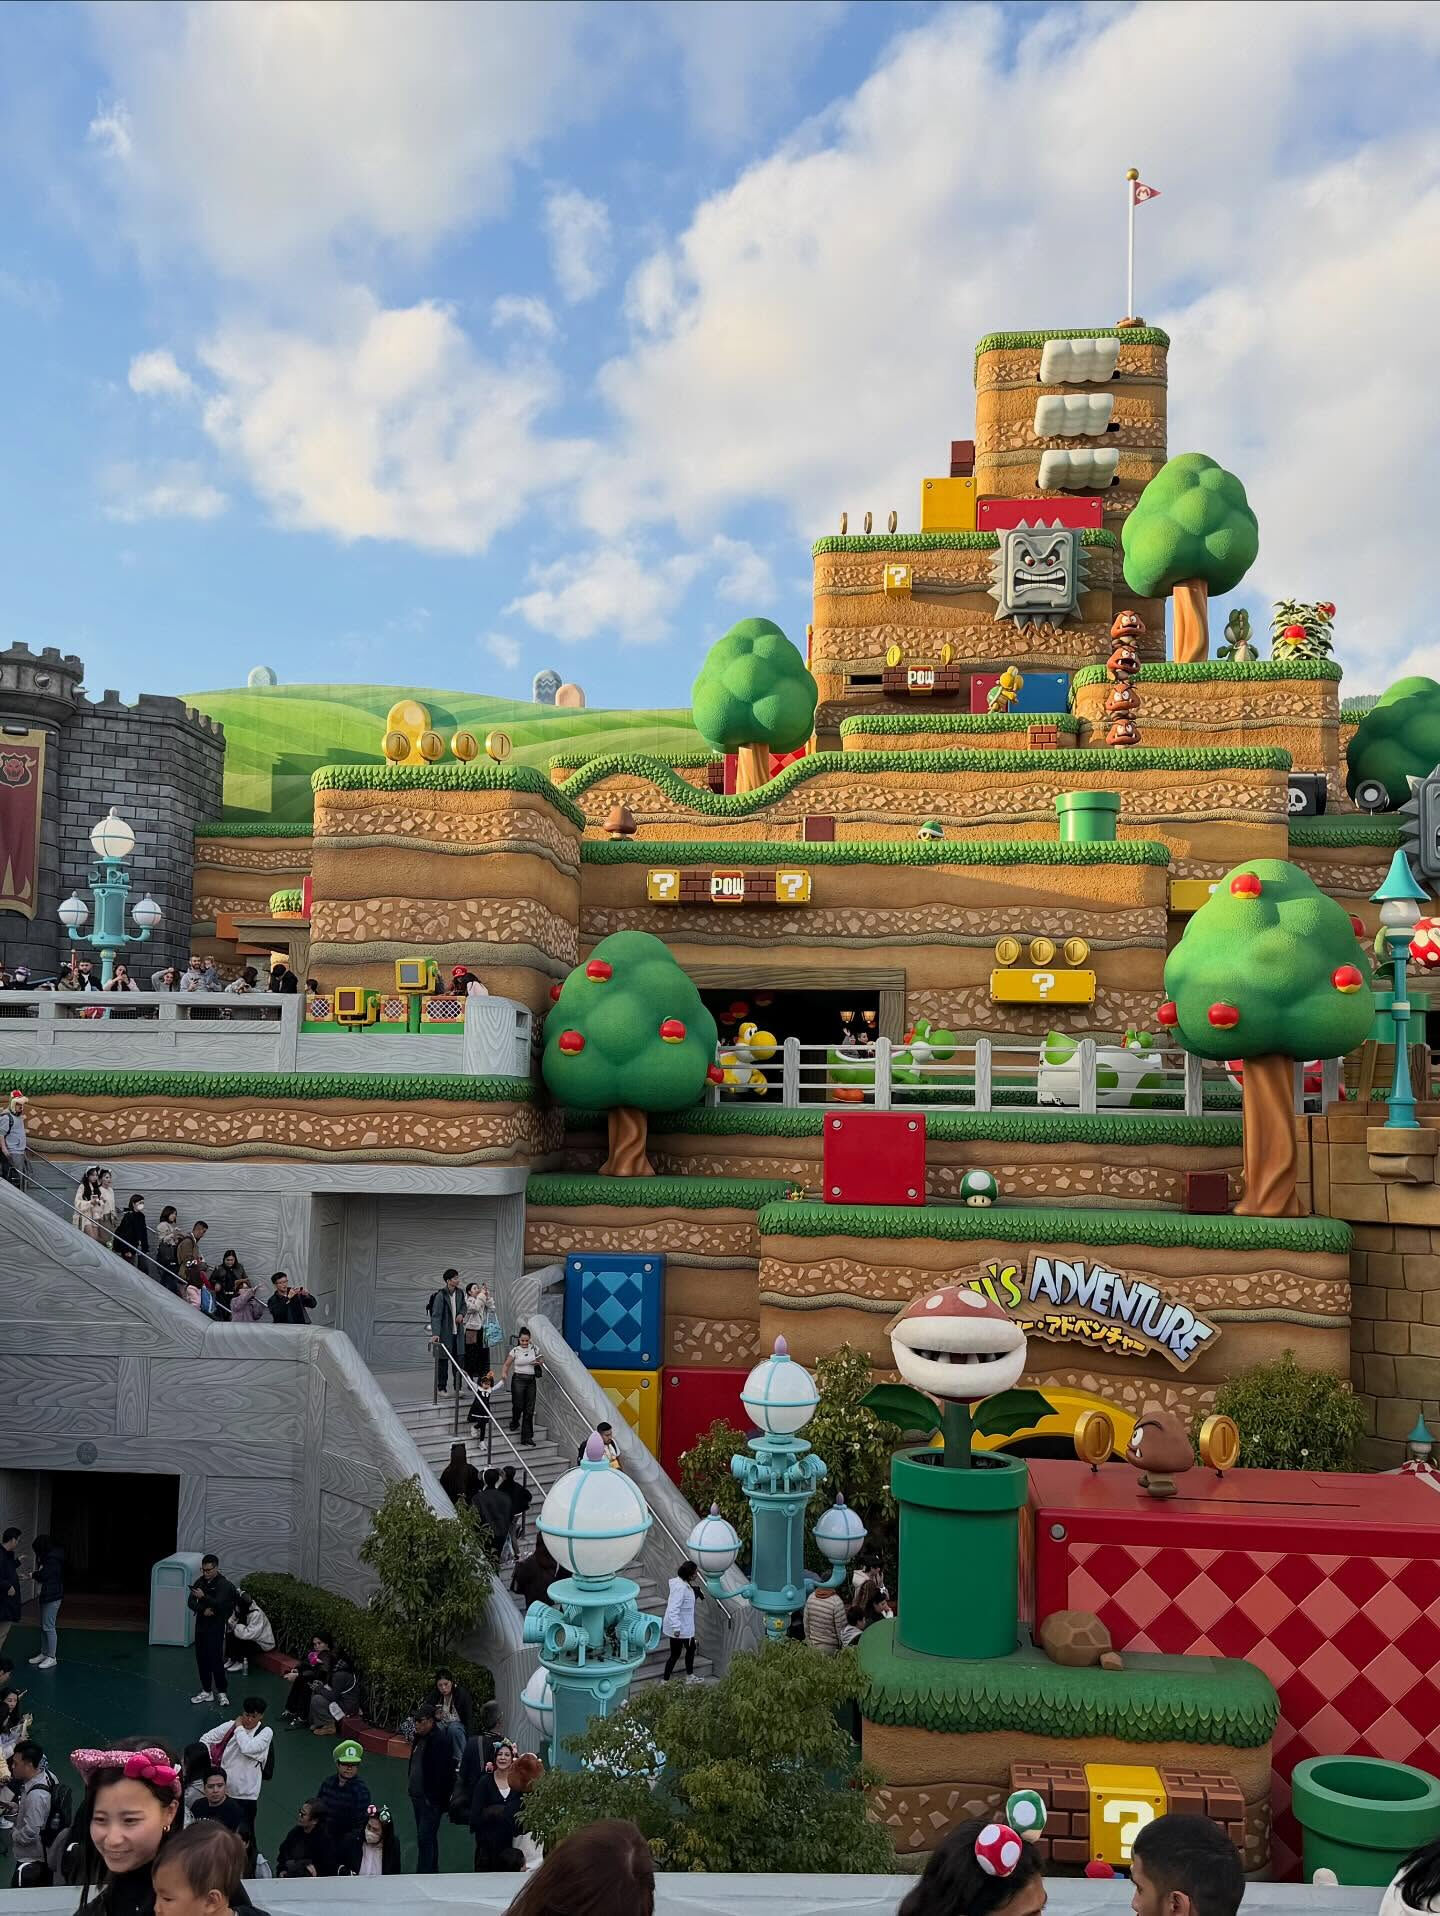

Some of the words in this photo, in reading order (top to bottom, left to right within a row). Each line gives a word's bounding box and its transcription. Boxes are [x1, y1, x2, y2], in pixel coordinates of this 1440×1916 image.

[889, 567, 906, 586] ?
[908, 670, 935, 685] POW
[652, 873, 675, 897] ?
[711, 877, 744, 895] POW
[781, 874, 803, 898] ?
[1032, 973, 1055, 998] ?
[1029, 1256, 1215, 1362] ADVENTURE
[1104, 1799, 1155, 1859] ?
